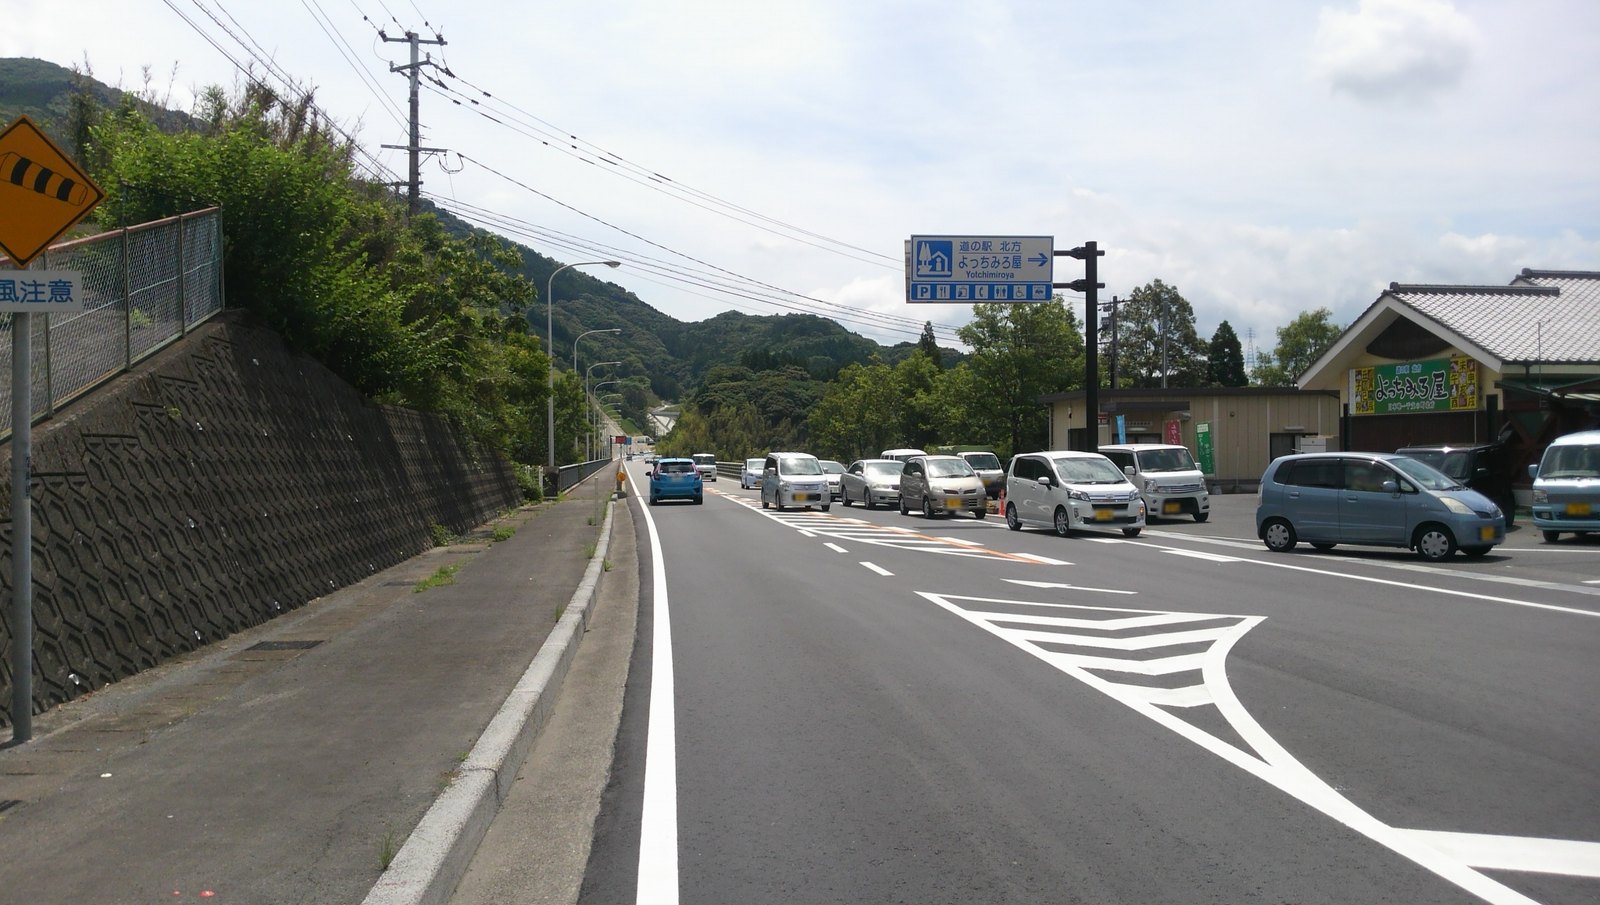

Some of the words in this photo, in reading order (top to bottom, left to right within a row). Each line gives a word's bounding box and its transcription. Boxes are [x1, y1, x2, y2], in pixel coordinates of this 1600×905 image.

[959, 241, 993, 252] 道の駅
[999, 241, 1022, 252] 北方
[958, 256, 1022, 269] よっちみろ屋
[966, 271, 1015, 280] Yotchimiroya
[1376, 370, 1448, 401] よっちみろ屋
